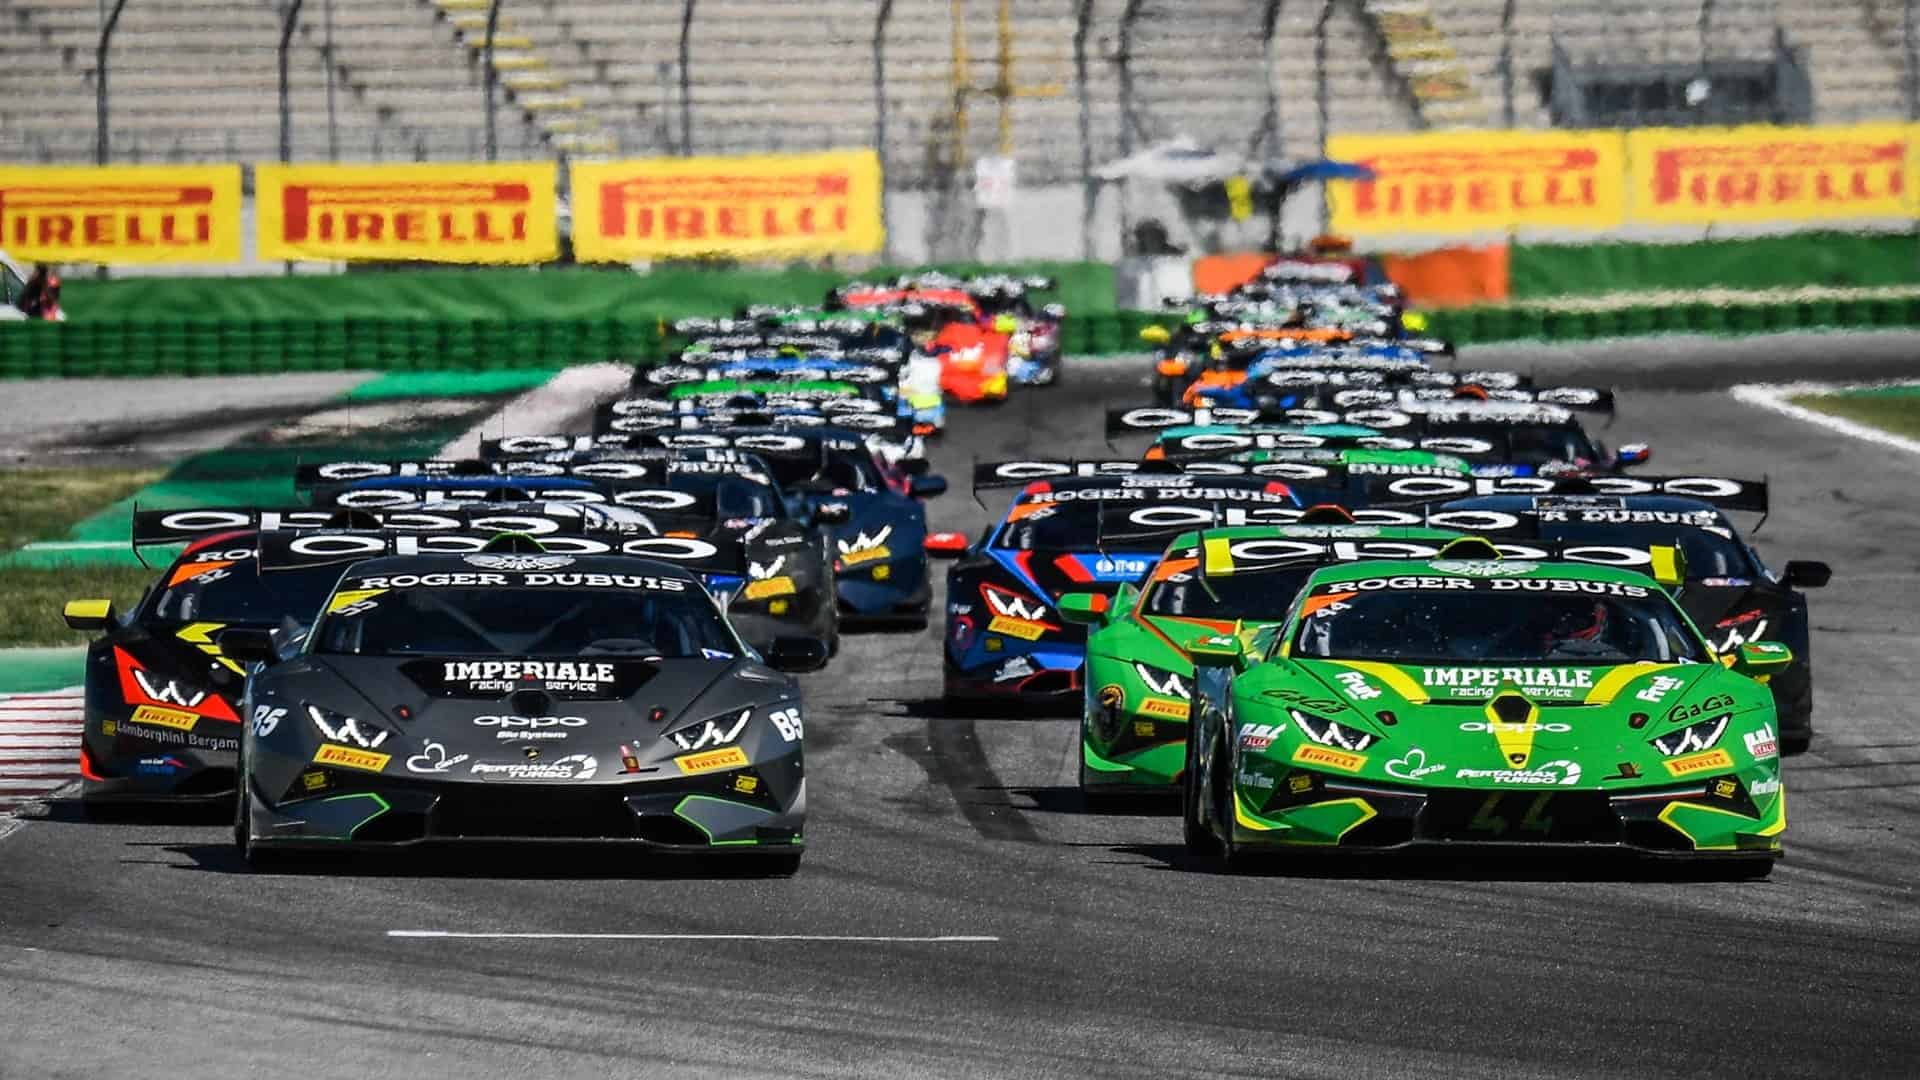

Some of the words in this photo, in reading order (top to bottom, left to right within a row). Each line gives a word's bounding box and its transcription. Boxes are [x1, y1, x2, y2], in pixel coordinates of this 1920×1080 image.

[1354, 149, 1598, 213] PIRELLI
[1655, 144, 1906, 203] PIRELLI
[283, 183, 530, 244] PIRELLI
[602, 175, 848, 238] PIRELLI
[1030, 488, 1144, 503] ROGER
[161, 511, 559, 535] oppo
[1129, 506, 1518, 530] oppo
[290, 534, 718, 559] oppo
[1230, 540, 1652, 566] oppo
[360, 574, 508, 590] ROGER
[526, 574, 685, 592] DUBUIS
[1328, 576, 1475, 594] ROGER
[1492, 577, 1649, 599] DUBUIS
[443, 661, 615, 683] IMPERIALE
[1423, 667, 1593, 687] IMPERIALE
[470, 679, 514, 692] racing
[545, 679, 597, 692] service
[1449, 687, 1494, 698] racing
[1522, 687, 1574, 698] service
[138, 709, 192, 726] PIRELLI
[1668, 694, 1735, 722] GaGa
[116, 719, 185, 744] Lamborghini
[473, 716, 588, 728] oppo
[1459, 722, 1572, 734] oppo
[322, 748, 382, 767] PIRELLI
[685, 751, 740, 770] PIRELLI
[1299, 747, 1359, 768] PIRELLI
[1671, 753, 1728, 775] PIRELLI
[509, 771, 572, 779] TURBO
[1494, 776, 1557, 784] TURBO
